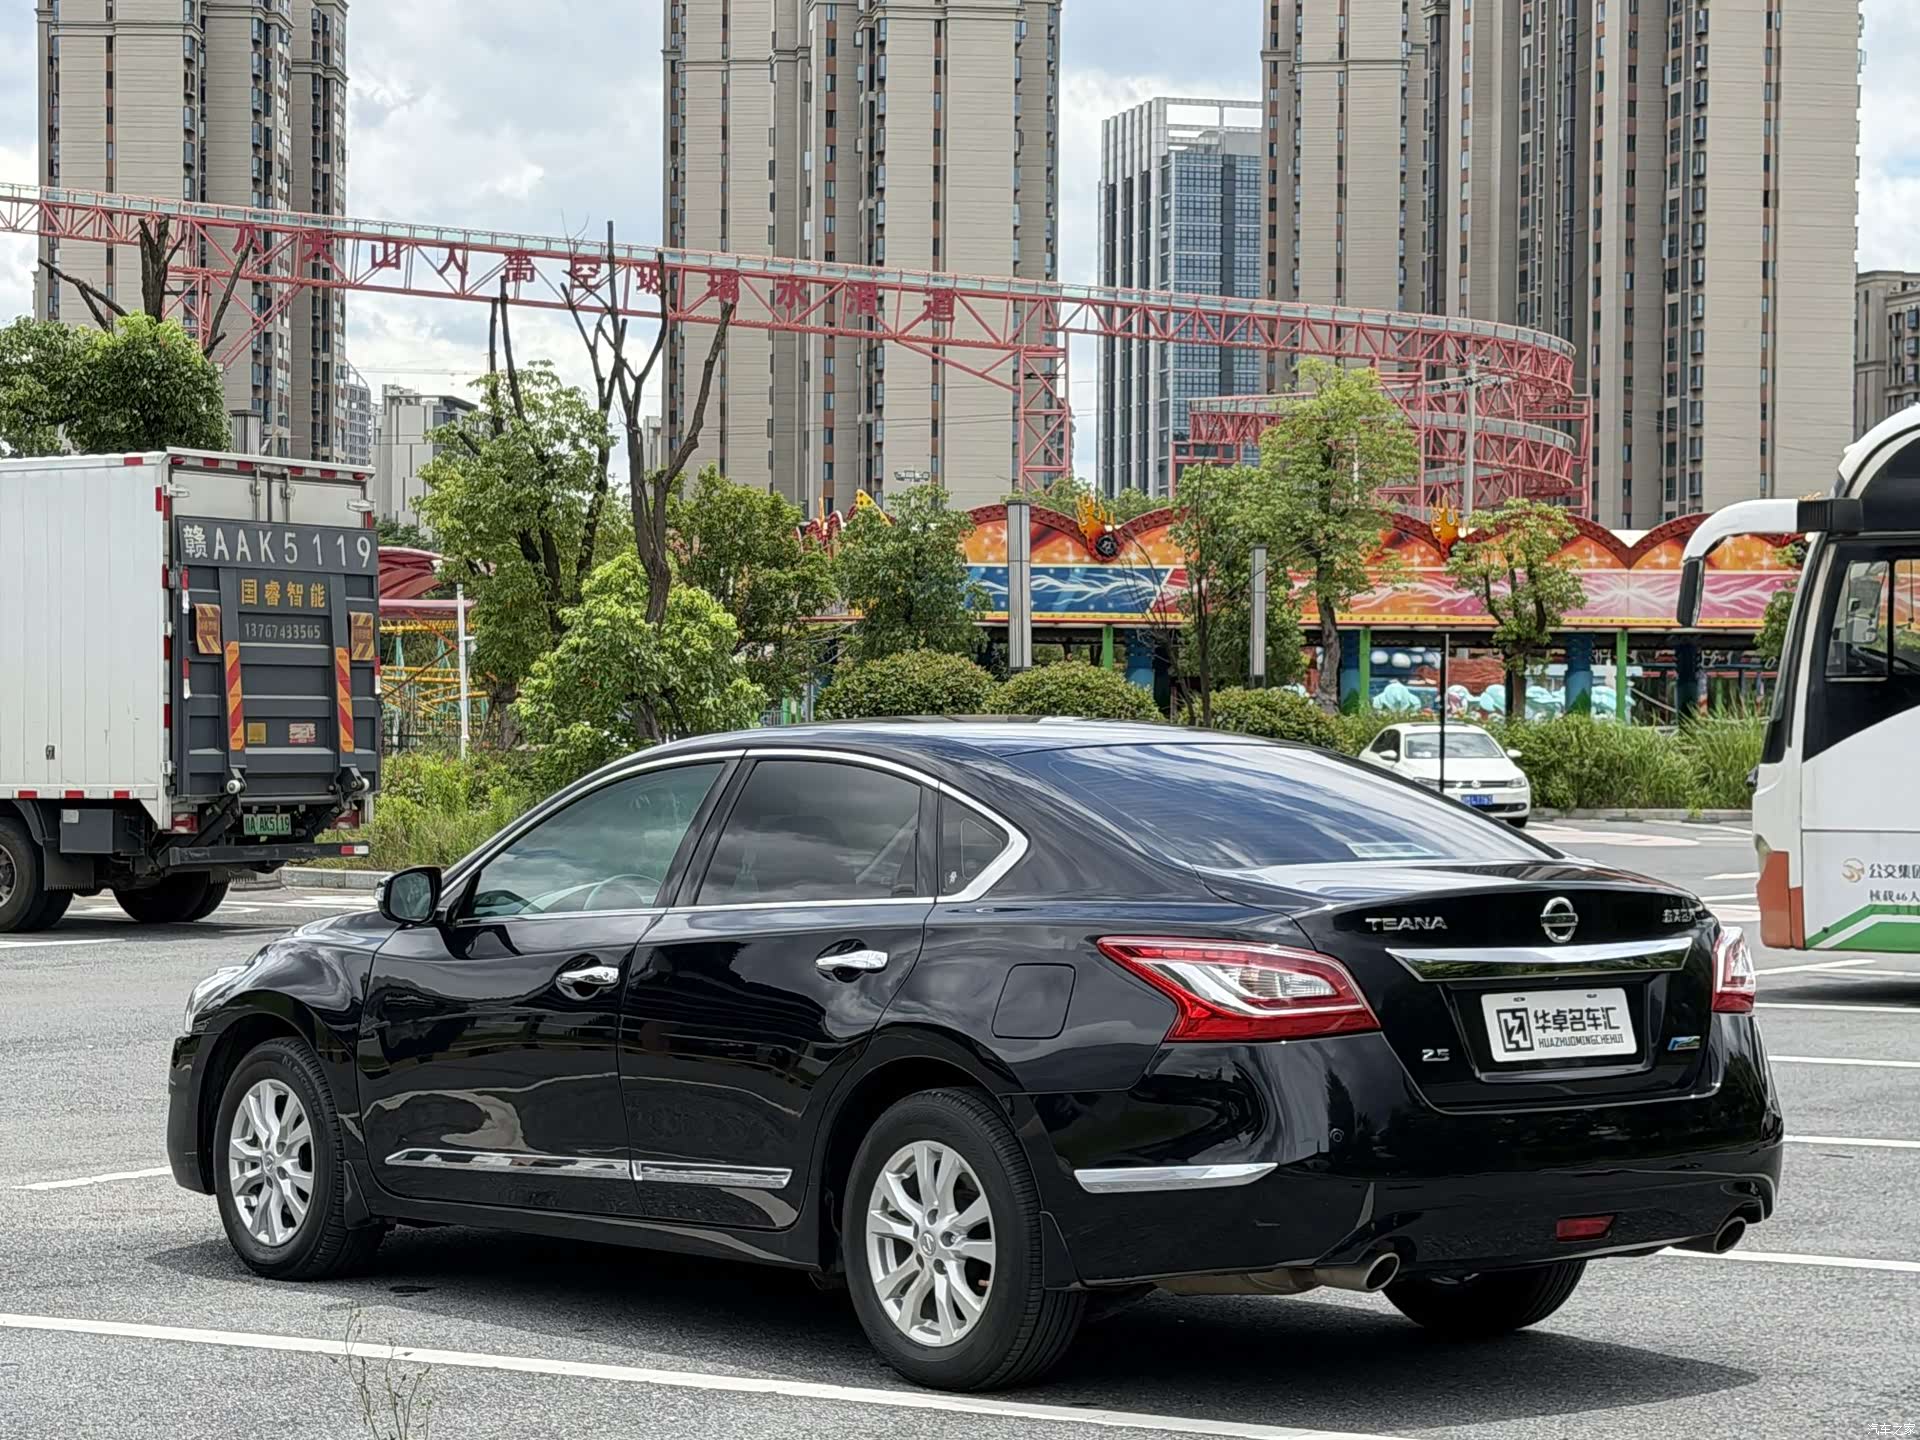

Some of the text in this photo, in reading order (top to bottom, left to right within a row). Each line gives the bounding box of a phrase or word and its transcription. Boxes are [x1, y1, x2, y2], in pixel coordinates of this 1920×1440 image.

[183, 524, 371, 568] 赣AAK5119
[241, 578, 326, 608] 国睿智能
[1365, 916, 1448, 931] TEANA
[1534, 1006, 1620, 1034] 华卓名车汇
[1538, 1033, 1624, 1049] HUAZHUOMINGCHEHUI
